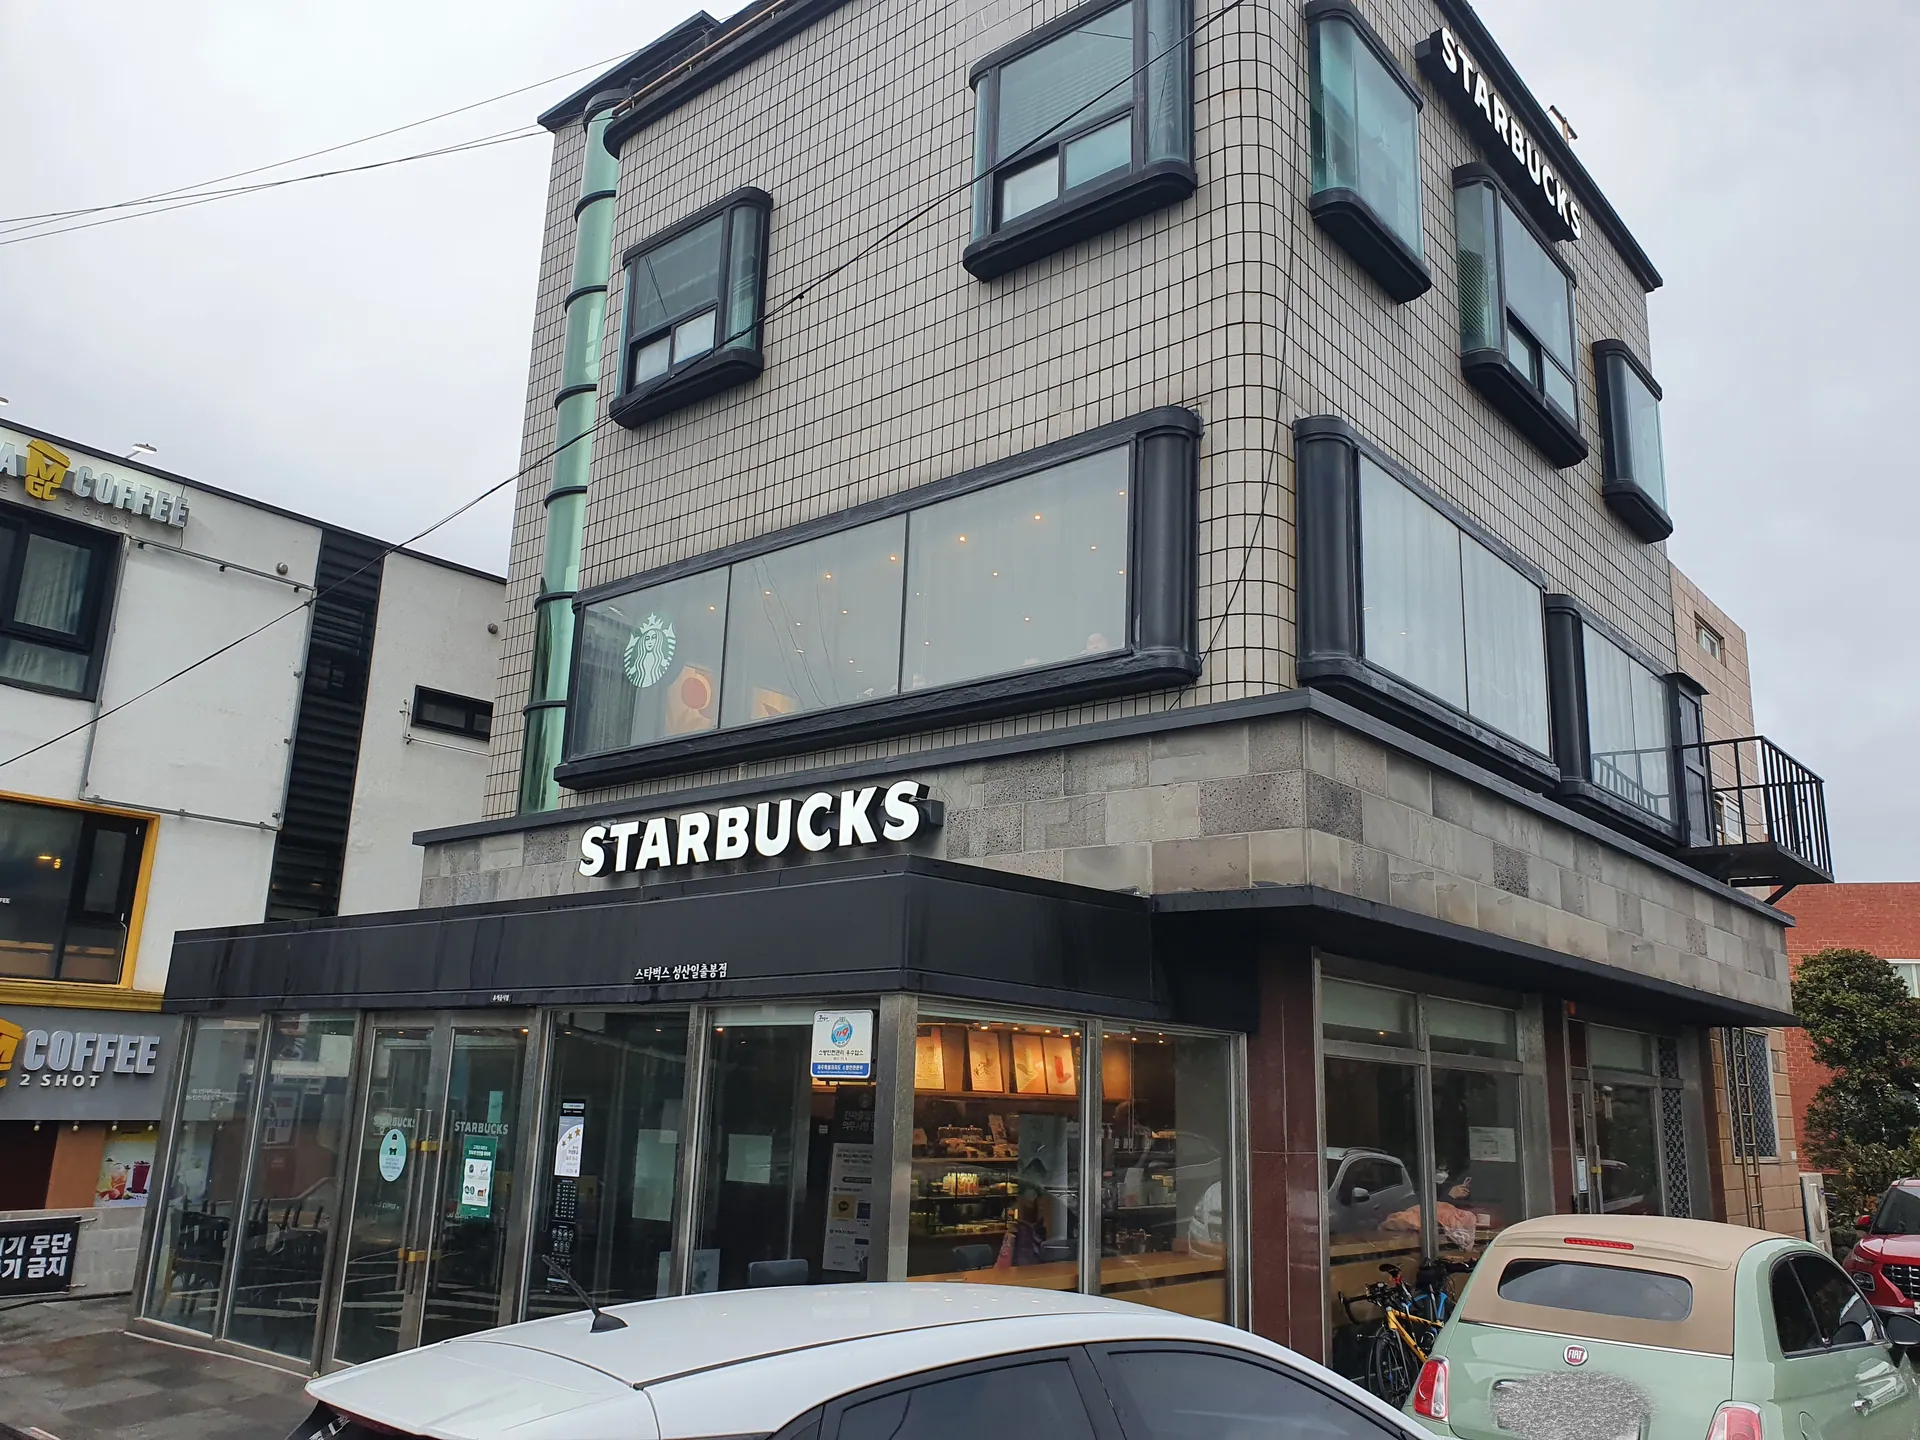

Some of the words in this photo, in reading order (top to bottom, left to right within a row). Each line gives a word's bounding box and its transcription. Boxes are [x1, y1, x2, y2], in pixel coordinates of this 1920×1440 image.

[1441, 27, 1582, 240] STARBUCKS
[72, 465, 190, 528] COFFEE
[82, 505, 132, 529] SHOT
[578, 780, 921, 877] STARBUCKS
[634, 965, 671, 981] 스타벅스
[672, 962, 728, 980] 성산일출봉점
[23, 1029, 160, 1074] COFFEE
[19, 1073, 31, 1086] 2
[40, 1074, 100, 1087] SHOT
[454, 1121, 509, 1135] STARBUCKS
[0, 1236, 27, 1256] 기
[30, 1233, 72, 1255] 무단
[0, 1258, 22, 1279] 기
[27, 1256, 67, 1279] 금지
[1568, 1349, 1583, 1360] FIAT
